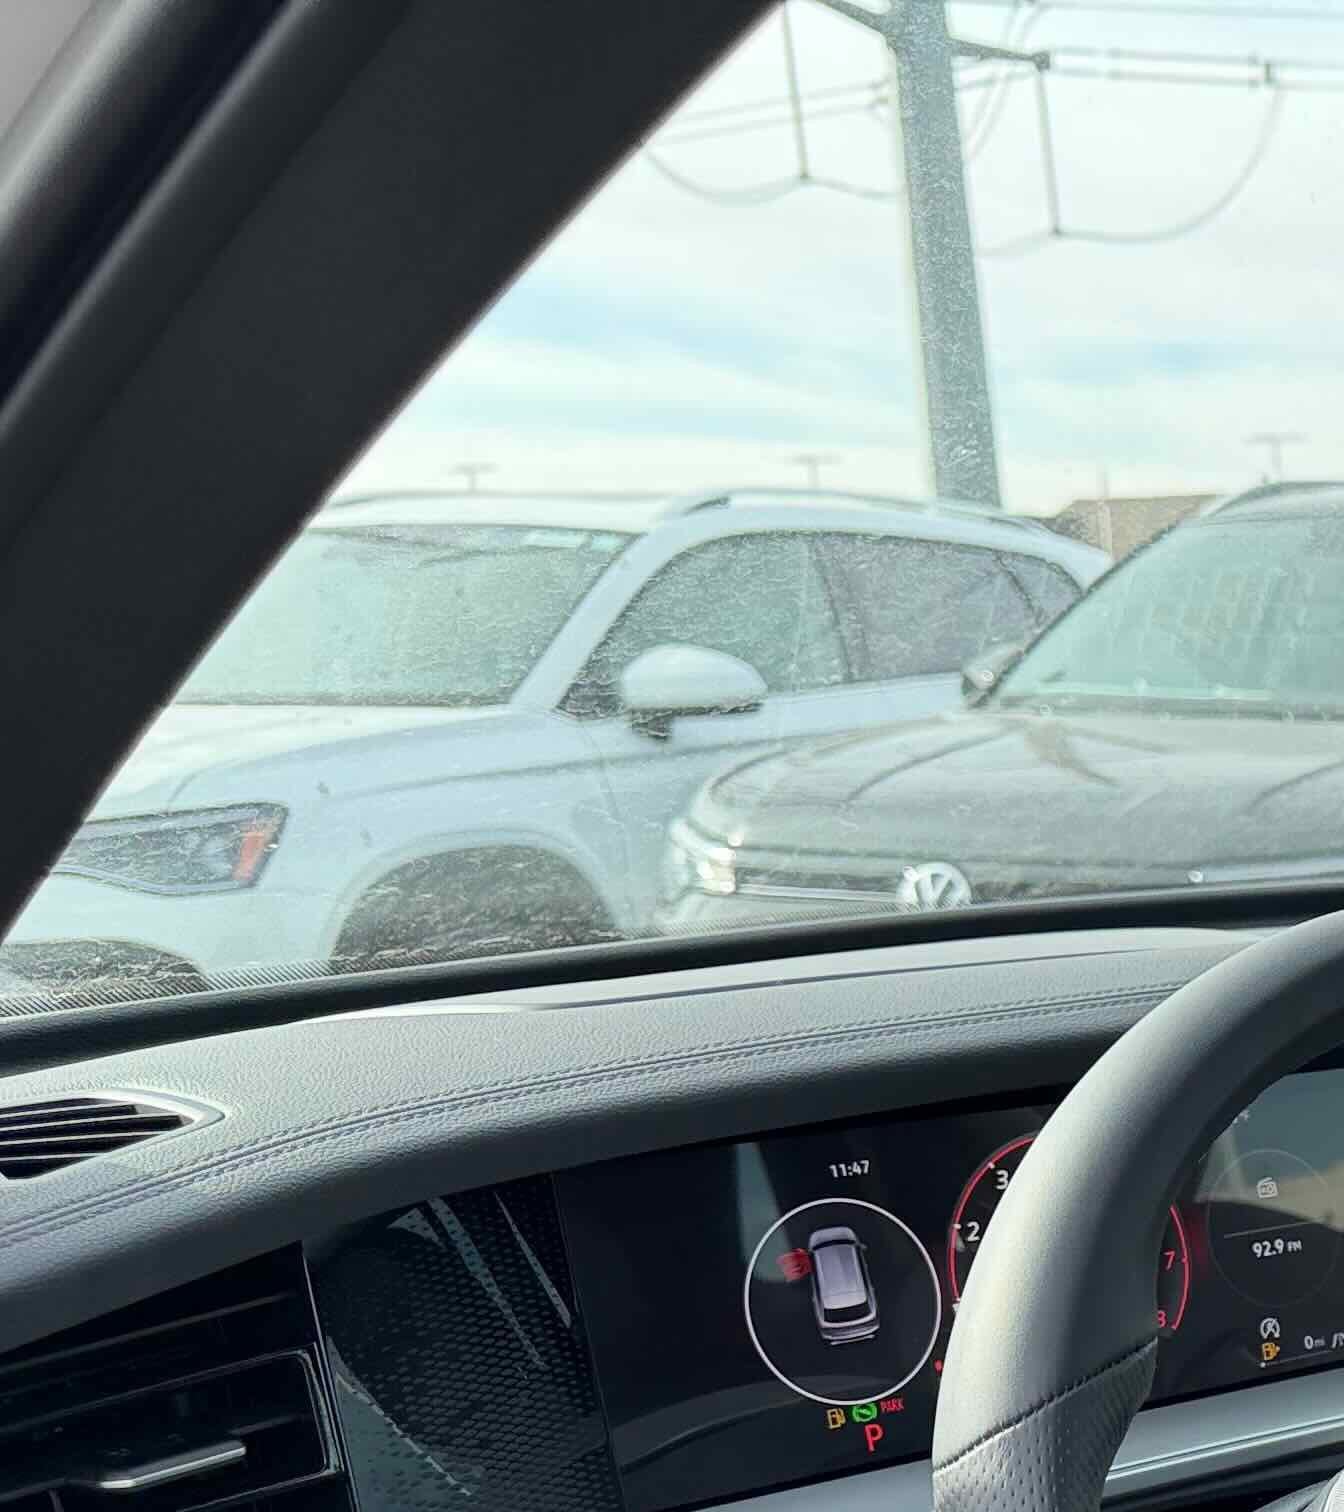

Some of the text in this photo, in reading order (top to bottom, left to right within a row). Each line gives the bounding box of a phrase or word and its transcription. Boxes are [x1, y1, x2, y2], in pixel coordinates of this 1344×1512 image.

[828, 1159, 870, 1178] 11:47
[996, 1169, 1009, 1190] 3
[966, 1221, 981, 1242] 2
[1252, 1238, 1303, 1258] 92.9 FM
[1163, 1249, 1176, 1271] 7
[880, 1397, 905, 1413] PARK
[864, 1423, 884, 1452] P
